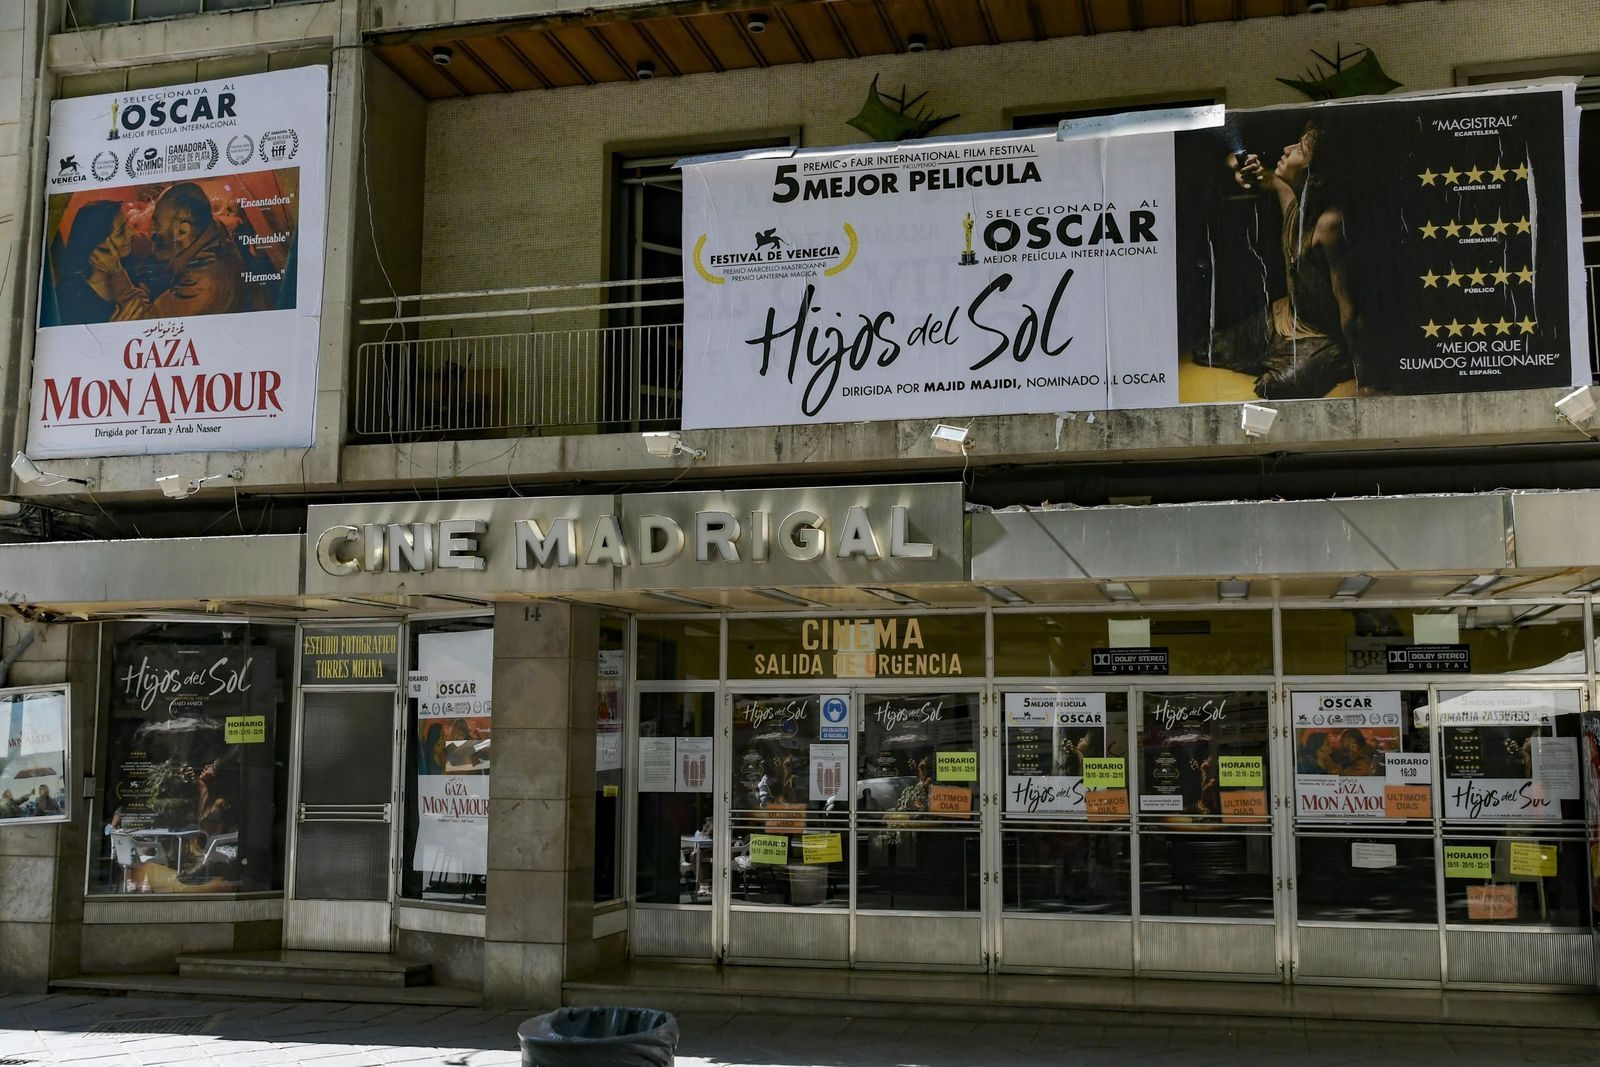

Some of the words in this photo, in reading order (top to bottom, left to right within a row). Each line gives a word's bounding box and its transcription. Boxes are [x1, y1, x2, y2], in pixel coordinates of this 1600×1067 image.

[123, 87, 208, 104] SELECCIONADA
[223, 83, 236, 91] AL
[121, 92, 237, 131] OSCAR
[122, 130, 145, 140] MEJOR
[147, 126, 178, 137] PELÍCULA
[180, 120, 237, 134] INTERNACIONAL
[1432, 115, 1518, 132] "MAGISTRAL"
[168, 142, 207, 154] GANADORA
[272, 145, 286, 157] tiff
[850, 158, 873, 167] FAJR
[877, 146, 960, 165] INTERNATIONAL
[964, 146, 988, 158] FILM
[990, 144, 1036, 156] FESTIVAL
[136, 157, 164, 172] SEMINCI
[168, 154, 186, 164] ESPIGA
[194, 151, 210, 161] PLATA
[52, 174, 87, 184] VENECIA
[772, 164, 800, 203] 5
[803, 172, 899, 200] MEJOR
[909, 162, 1042, 192] PELICULA
[236, 193, 294, 208] "Encantadora"
[986, 202, 1116, 218] SELECCIONADA
[1140, 200, 1158, 208] AL
[238, 232, 290, 246] "Disfrutable"
[983, 210, 1158, 252] OSCAR
[710, 252, 763, 265] FESTIVAL
[768, 250, 782, 261] DE
[786, 246, 840, 260] VENECIA
[984, 254, 1018, 264] MEJOR
[1022, 250, 1067, 262] PELÍCULA
[1071, 246, 1158, 259] INTERNACIONAL
[240, 270, 286, 283] "Hermosa"
[748, 265, 779, 274] MARCELLO
[781, 262, 827, 271] MASTROIANNI
[756, 272, 788, 281] LANTERNA
[745, 284, 901, 417] Hijos
[906, 306, 960, 346] del
[968, 268, 1074, 371] Sol
[1491, 340, 1521, 352] QUE
[123, 338, 200, 370] GAZA
[1400, 357, 1467, 370] SLUMDOG
[842, 382, 893, 397] DIRIGIDA
[896, 381, 920, 394] POR
[924, 379, 966, 393] MAJID
[970, 378, 1022, 392] MAJIDI,
[1026, 375, 1100, 388] NOMINADO
[1122, 372, 1166, 385] OSCAR
[40, 376, 133, 422] MON
[138, 370, 284, 424] AMOUR
[94, 426, 123, 438] Dirigida
[125, 428, 138, 437] por
[140, 425, 165, 436] Tarzan
[168, 427, 174, 435] y
[176, 424, 194, 434] Arab
[196, 424, 221, 433] Nasser
[314, 518, 487, 576] CINE
[514, 504, 938, 572] MADRIGAL
[522, 606, 541, 622] 14
[802, 618, 924, 650] CINEMA
[304, 636, 339, 655] ESTUDIO
[341, 635, 396, 654] FOTOGRAFICO
[316, 660, 349, 679] TORRES
[352, 659, 383, 678] MOLINA
[755, 653, 824, 675] SALIDA
[833, 654, 855, 675] DE
[865, 653, 962, 675] URGENCIA
[121, 656, 182, 711] Hijos
[184, 667, 206, 686] del
[209, 656, 253, 696] Sol
[440, 683, 476, 695] OSCAR
[1024, 698, 1031, 707] 5
[1324, 698, 1372, 708] OSCAR
[743, 701, 774, 729] Hijos
[786, 700, 808, 720] Sol
[874, 702, 908, 730] Hijos
[921, 701, 943, 723] Sol
[1060, 714, 1102, 723] OSCAR
[1152, 700, 1188, 730] Hijos
[1202, 700, 1226, 722] Sol
[1401, 768, 1417, 777] 16:30
[445, 782, 467, 796] GAZA
[1012, 778, 1055, 813] Hijos
[1056, 786, 1071, 798] del
[422, 796, 448, 814] MON
[450, 797, 488, 818] AMOUR
[933, 794, 968, 803] ULTIMOS
[940, 802, 960, 811] DIAS
[1302, 795, 1338, 810] MON
[1342, 796, 1385, 813] AMOU
[1452, 781, 1500, 819] Hijos
[1501, 790, 1517, 801] del
